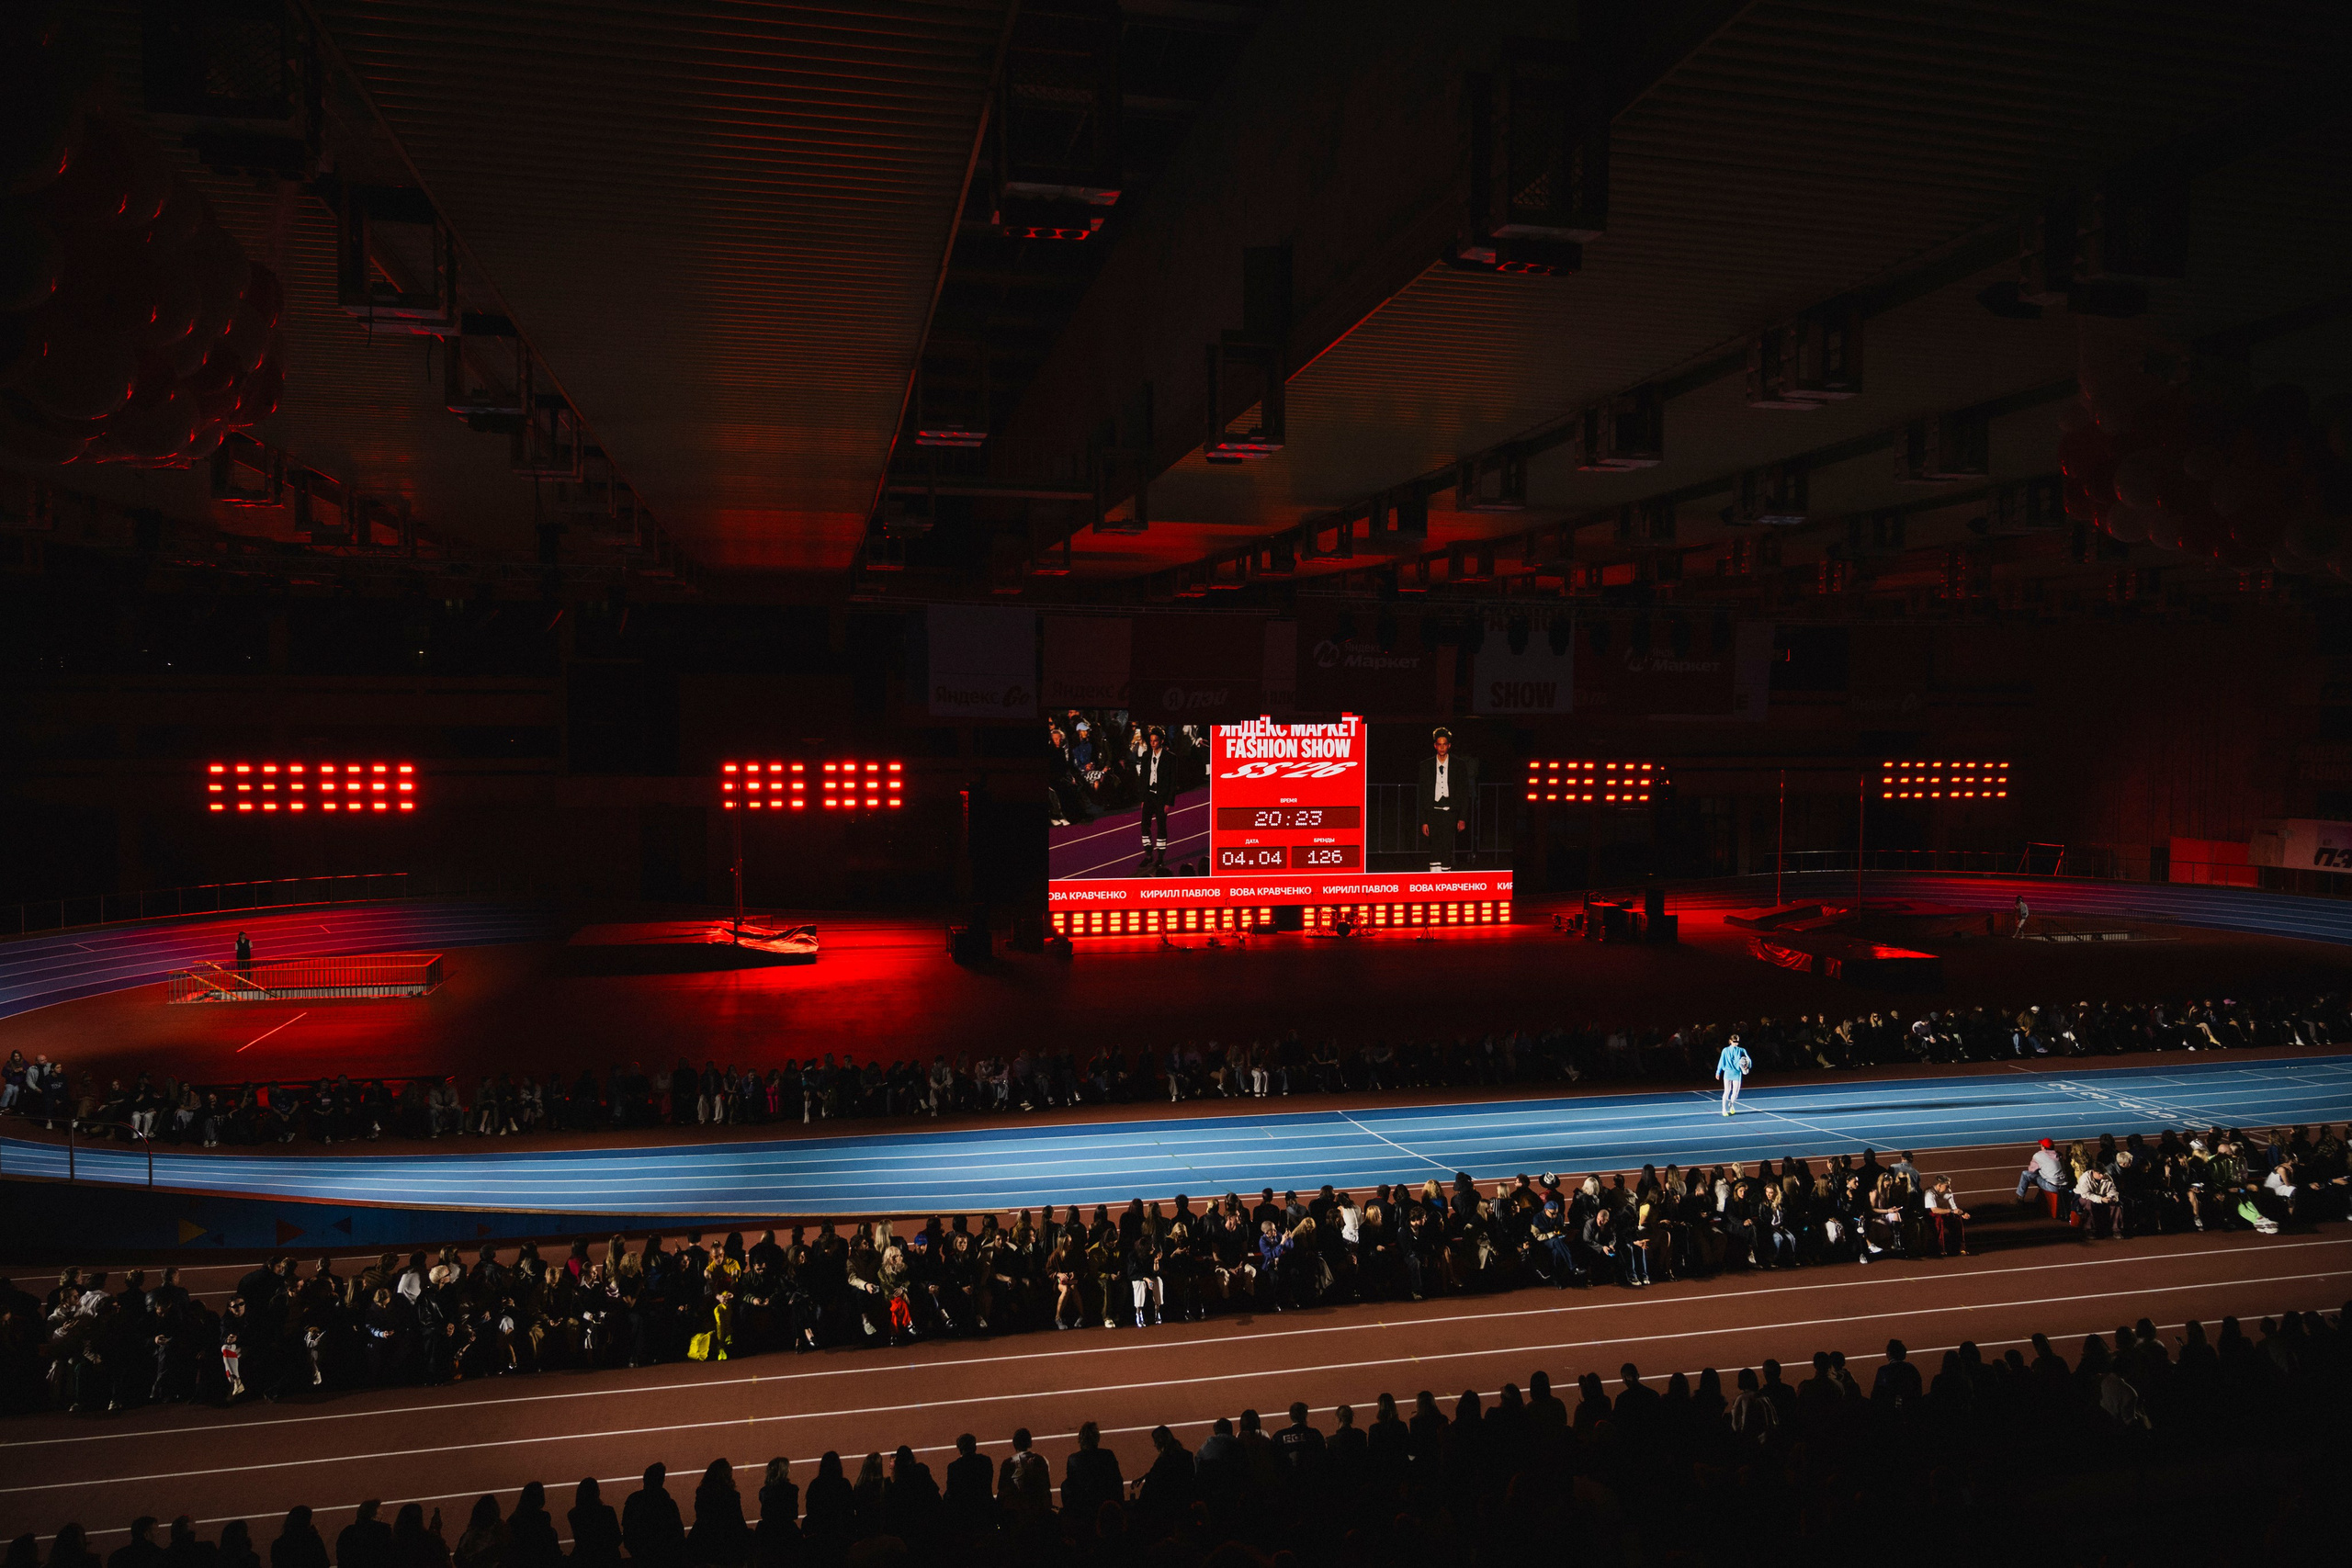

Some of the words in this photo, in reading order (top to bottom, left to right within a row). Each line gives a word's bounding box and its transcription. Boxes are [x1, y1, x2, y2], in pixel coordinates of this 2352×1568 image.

[1343, 655, 1420, 671] Маркет
[1651, 659, 1722, 673] Маркет
[935, 685, 1000, 706] Яндекс
[1002, 684, 1031, 708] Go
[1490, 680, 1557, 709] SHOW
[1290, 716, 1359, 737] МАРКЕТ
[1226, 738, 1298, 759] FASHION
[1301, 738, 1351, 759] SHOW
[1220, 761, 1358, 779] SS'26
[1254, 810, 1323, 827] 20:23
[1222, 851, 1283, 866] 04.04
[1307, 850, 1343, 864] 126
[1069, 889, 1127, 900] КРАВЧЕНКО
[1140, 889, 1181, 899] КИРИЛЛ
[1182, 887, 1221, 898] ПАВЛОВ
[1229, 887, 1256, 897] ВОВА
[1257, 886, 1312, 897] КРАВЧЕНКО
[1322, 885, 1361, 895] КИРИЛЛ
[1362, 884, 1399, 894] ПАВЛОВ
[1409, 883, 1434, 893] ВОВА
[1435, 882, 1487, 892] КРАВЧЕНКО
[2047, 1082, 2077, 1091] 2
[2079, 1090, 2109, 1100] 3
[2118, 1100, 2145, 1110] 4
[2144, 1110, 2178, 1120] 5
